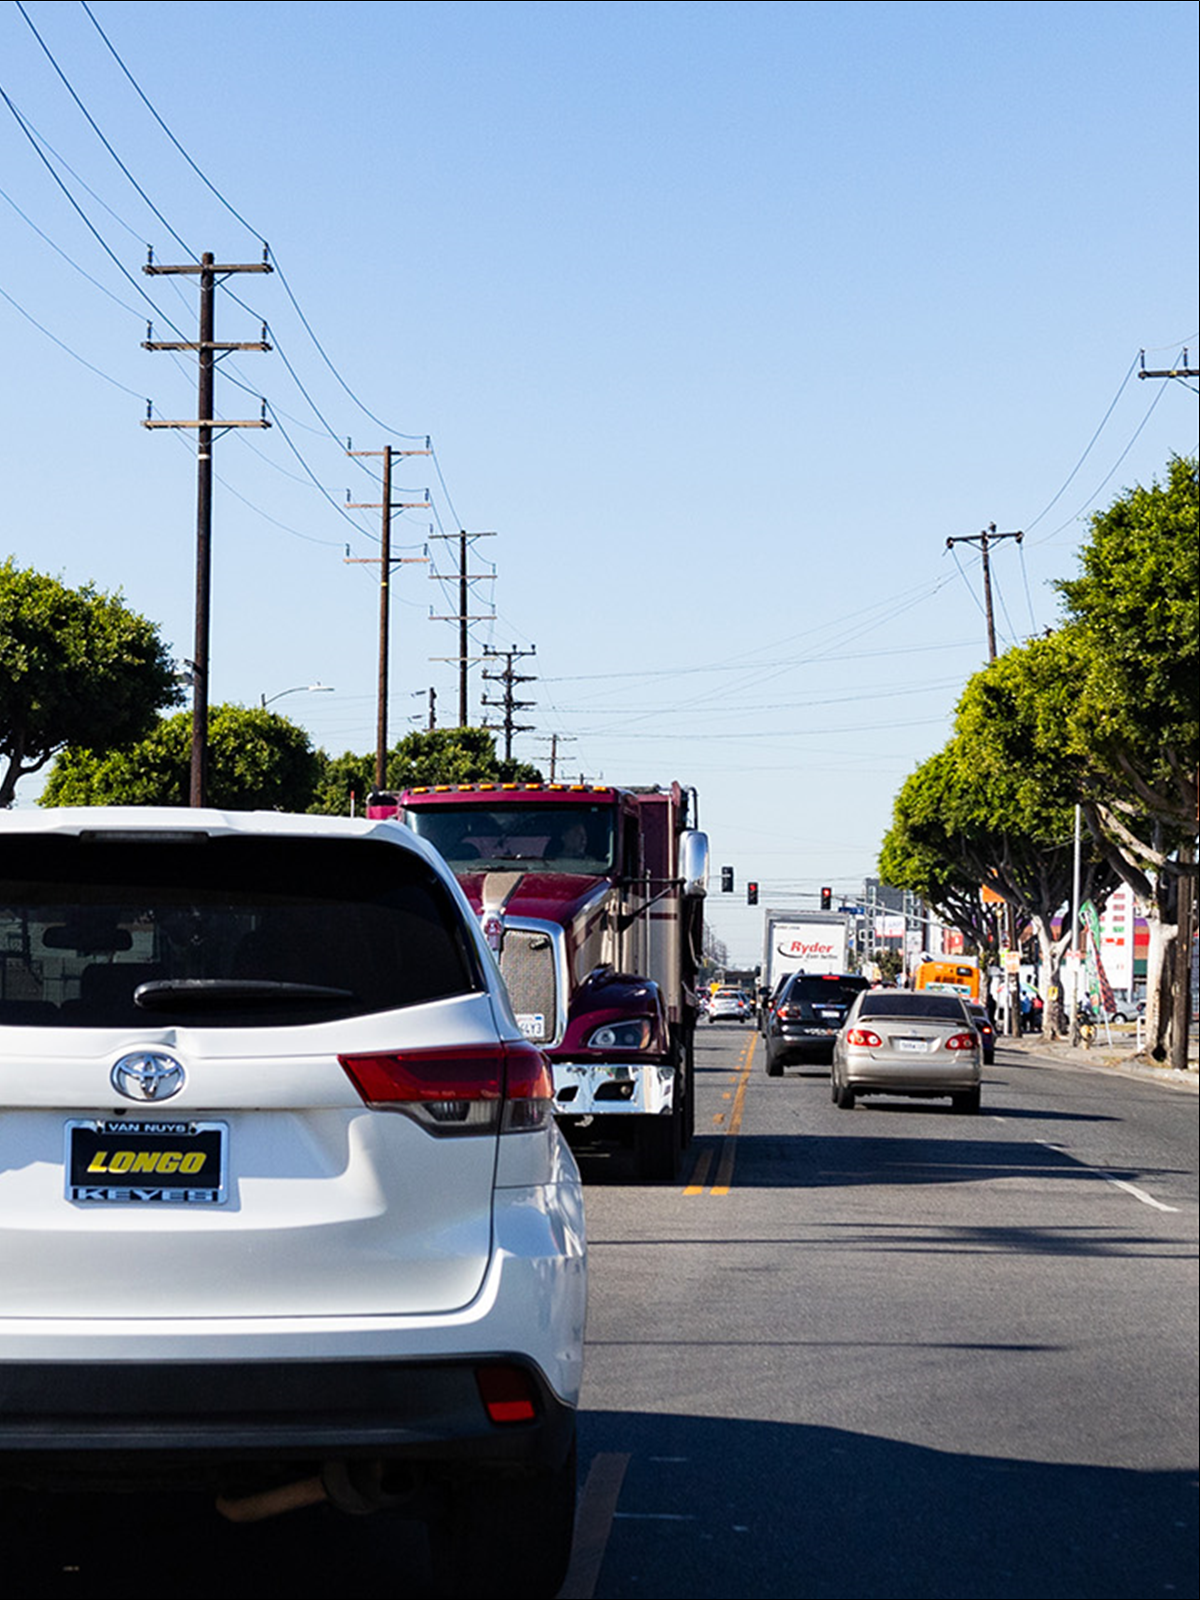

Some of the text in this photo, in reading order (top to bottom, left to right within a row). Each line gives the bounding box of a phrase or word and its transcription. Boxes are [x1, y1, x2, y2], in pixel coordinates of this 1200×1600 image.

[790, 941, 834, 954] Ryder
[108, 1122, 186, 1133] VAN NUYS
[87, 1151, 207, 1174] LONGO
[77, 1188, 214, 1201] KEYES
